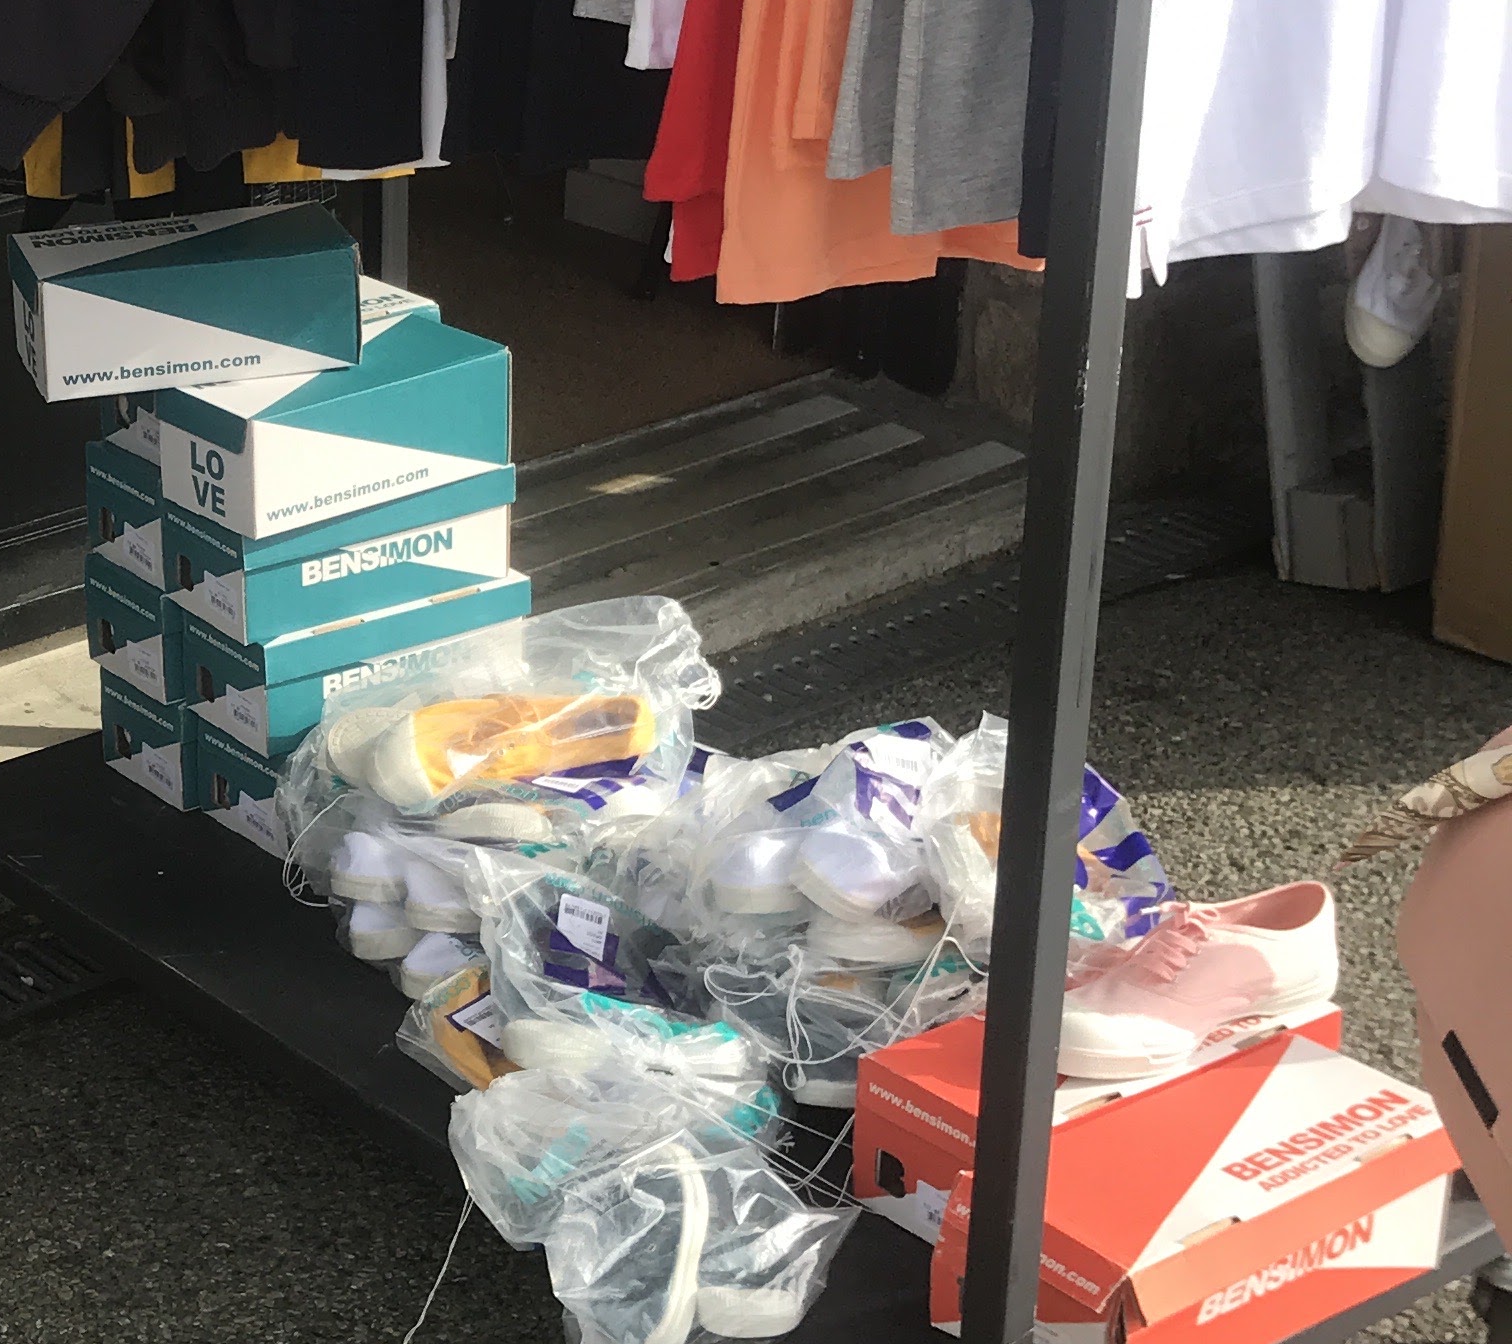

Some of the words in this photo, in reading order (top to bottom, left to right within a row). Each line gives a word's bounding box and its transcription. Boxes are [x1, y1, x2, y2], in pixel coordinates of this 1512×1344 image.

[32, 223, 199, 249] BENSIMON
[62, 352, 262, 387] www.bensimon.com
[190, 440, 225, 481] LO
[89, 465, 156, 506] www.bensimon.com
[191, 475, 226, 518] VE
[266, 467, 430, 522] www.bensimon.com
[166, 511, 238, 558] www.bensimon.com
[301, 527, 453, 587] BENSIMON
[89, 576, 157, 623] www.bensimon.com
[189, 623, 261, 673] www.bensimon.com
[104, 684, 175, 733] www.bensimon.com
[204, 732, 282, 780] www.bensimon.co
[868, 1081, 977, 1149] www.bensimon.
[1221, 1088, 1411, 1183] BENSIMON
[1257, 1143, 1354, 1193] ADDICTED
[1347, 1128, 1381, 1146] TO
[1376, 1103, 1433, 1133] LOVE
[1196, 1212, 1375, 1327] BENSIMON
